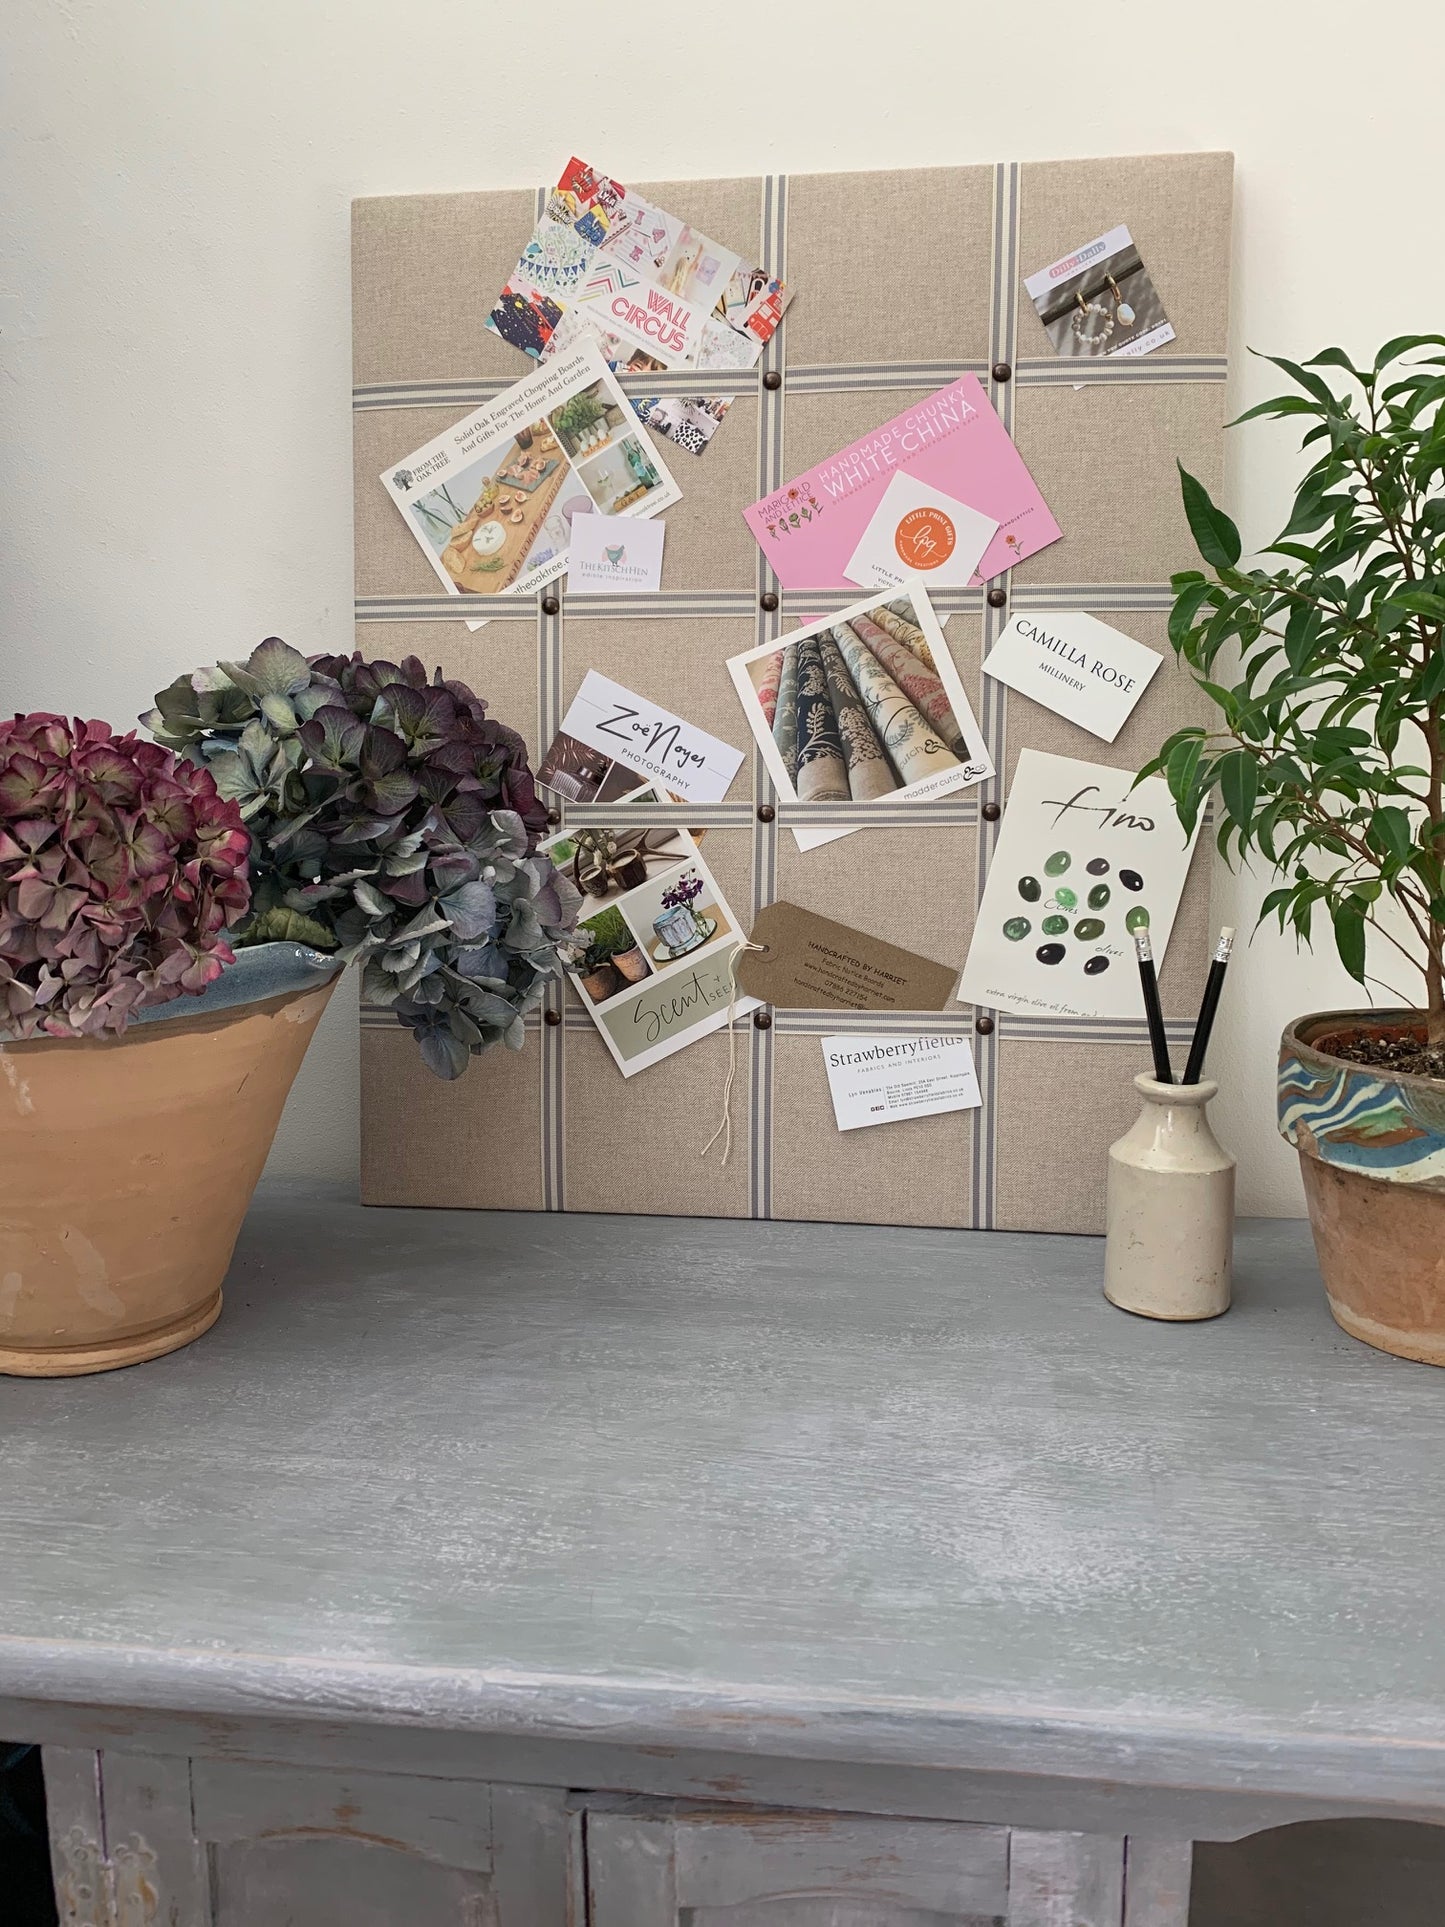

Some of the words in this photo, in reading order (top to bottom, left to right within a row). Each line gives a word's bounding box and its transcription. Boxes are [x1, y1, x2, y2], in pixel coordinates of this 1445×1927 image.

[611, 297, 685, 352] CIRCUS
[647, 288, 692, 332] WALL
[454, 426, 475, 445] Solid
[474, 414, 491, 433] Oak
[490, 395, 525, 422] Engraved
[523, 371, 560, 404] Chopping
[557, 355, 585, 379] Boards
[461, 438, 478, 456] And
[477, 427, 496, 446] Gifts
[495, 419, 509, 433] For
[508, 407, 526, 424] The
[525, 394, 548, 414] Home
[547, 385, 563, 401] And
[562, 365, 591, 391] Garden
[818, 426, 903, 485] HANDMADE
[905, 386, 967, 431] CHUNKY
[823, 445, 898, 499] WHITE
[901, 400, 977, 452] CHINA
[412, 457, 434, 477] FROM
[431, 449, 447, 467] THE
[415, 468, 433, 483] OAK
[430, 457, 451, 475] TREE
[765, 509, 783, 524] AND
[905, 511, 927, 525] LITTLE
[928, 511, 948, 526] PRINT
[945, 525, 954, 546] GIFTS
[871, 564, 894, 579] LITTLE
[1016, 619, 1088, 669] CAMILLA
[1090, 660, 1136, 694] ROSE
[1038, 662, 1087, 692] MILLINERY
[595, 703, 651, 742] Zoë
[643, 721, 706, 769] Noyes
[621, 747, 691, 791] PHOTOGRAPHY
[900, 745, 924, 770] cutch
[903, 781, 939, 801] madder
[939, 771, 964, 787] cutch
[808, 941, 861, 968] HANDCRAFTED
[862, 963, 873, 973] BY
[873, 968, 908, 986] HARRIET
[1095, 944, 1125, 957] olives
[822, 957, 842, 972] Fabric
[842, 966, 864, 980] Notice
[863, 974, 885, 988] Boards
[633, 972, 709, 1042] Scent
[986, 988, 1005, 997] extra
[1008, 992, 1029, 1004] virgin
[1031, 998, 1048, 1008] olive
[1049, 1003, 1059, 1011] oil
[1059, 1004, 1078, 1015] from
[829, 1037, 964, 1068] Strawberryfields
[857, 1064, 885, 1074] FABRICS
[905, 1054, 942, 1065] INTERIORS
